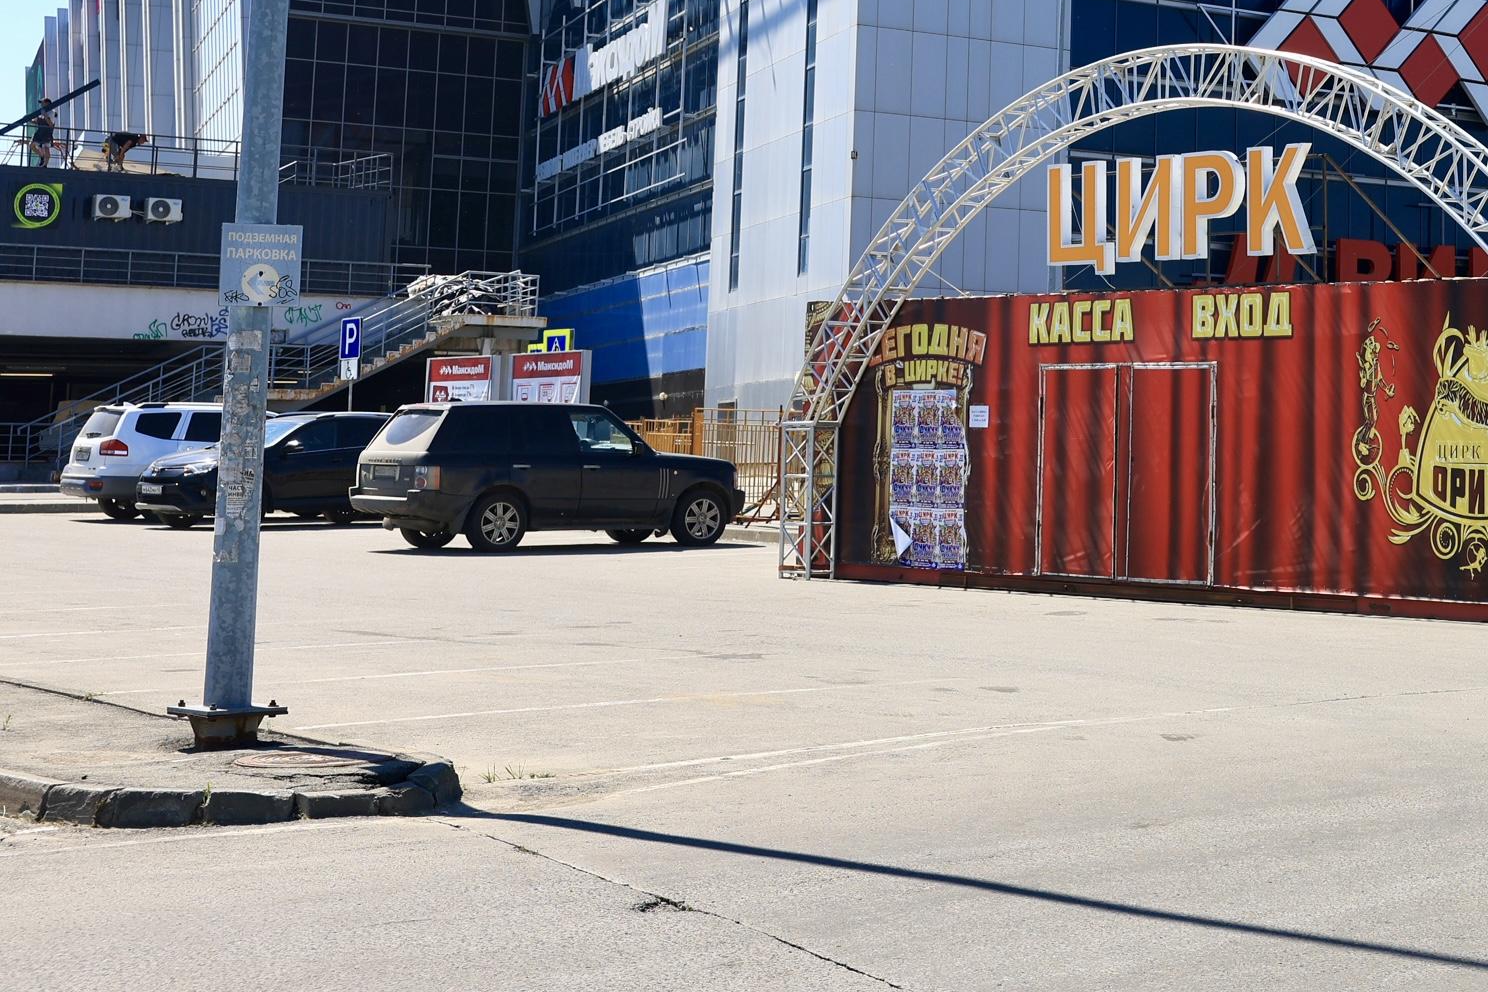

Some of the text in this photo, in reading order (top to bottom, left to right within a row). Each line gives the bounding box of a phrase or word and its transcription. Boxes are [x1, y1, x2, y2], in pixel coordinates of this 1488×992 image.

[1047, 142, 1317, 275] ЦИРК
[228, 231, 298, 245] ПОДЗЕМНАЯ
[226, 247, 297, 261] ПАРКОВКА
[1029, 298, 1134, 344] КАССА
[1192, 292, 1292, 338] ВХОД
[345, 322, 358, 355] P
[884, 359, 965, 387] В ЦИРКЕ!
[1437, 443, 1481, 462] ЦИРК
